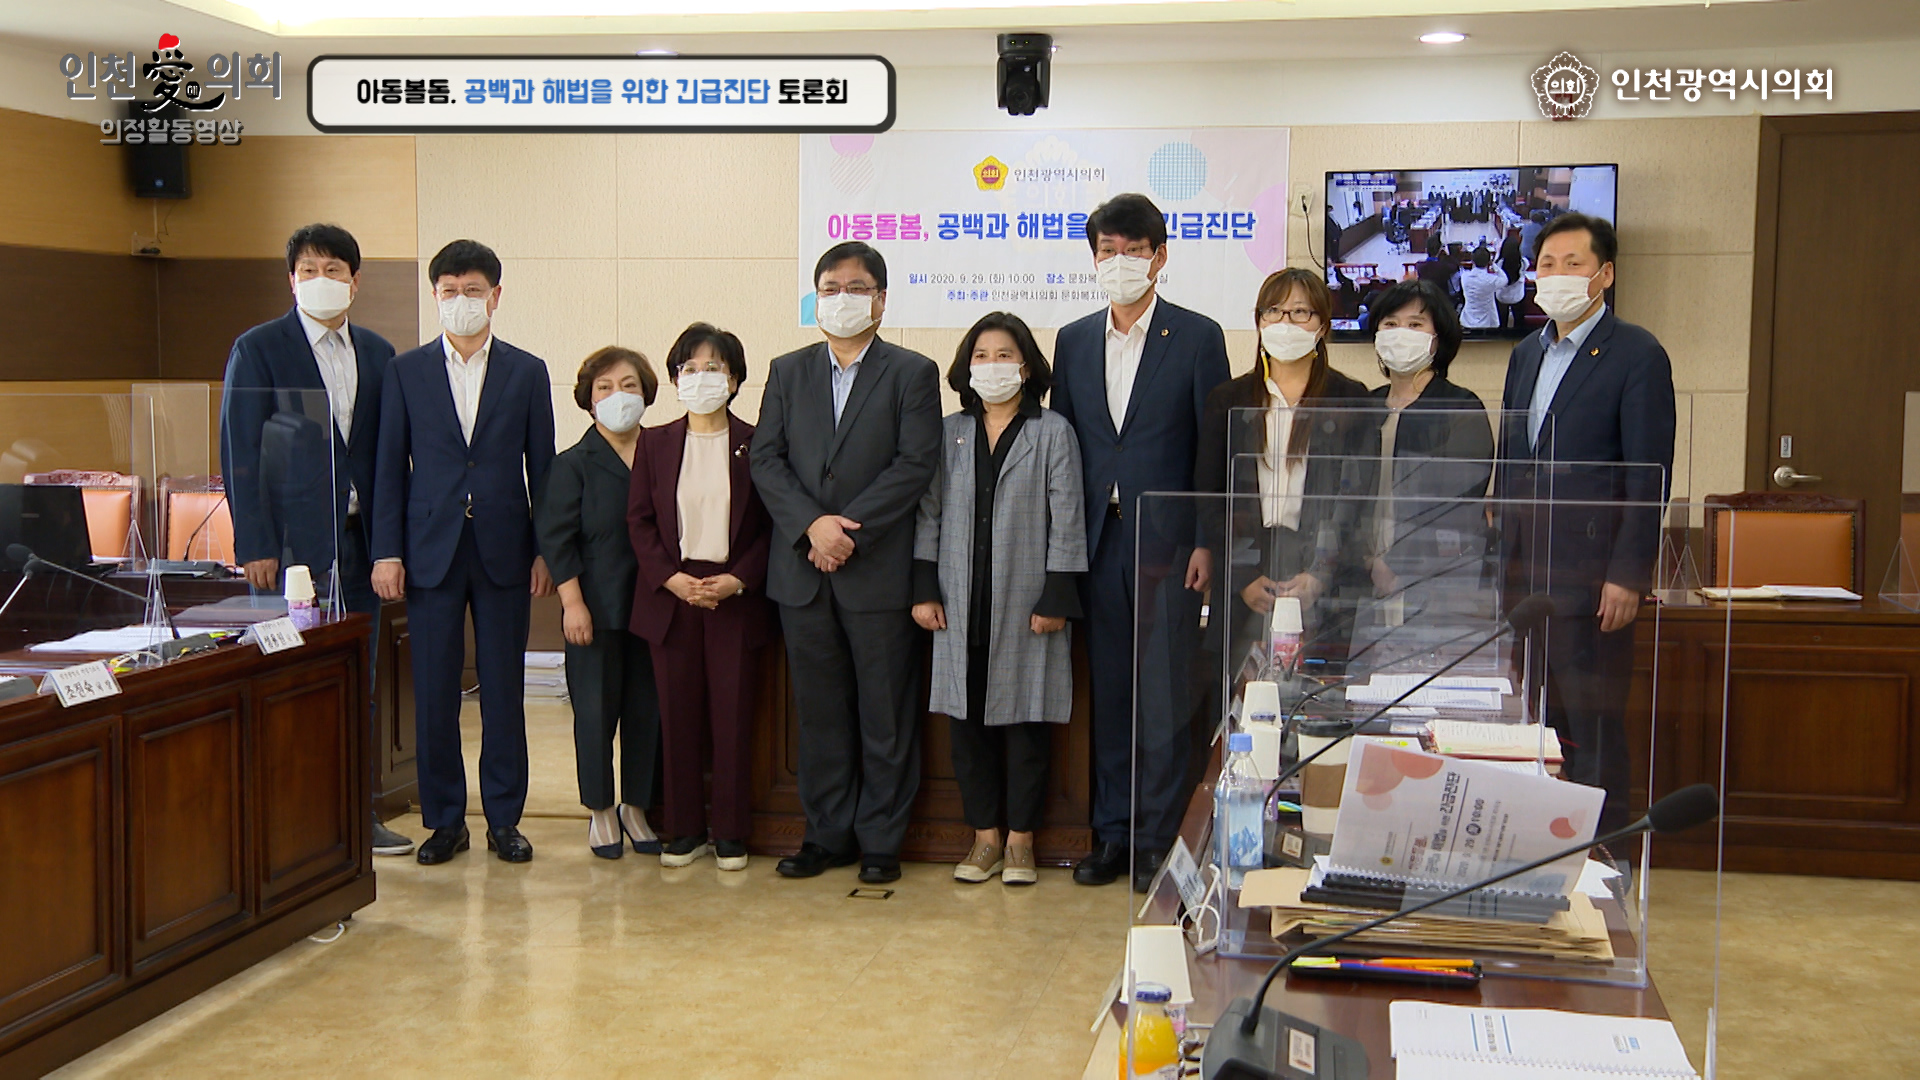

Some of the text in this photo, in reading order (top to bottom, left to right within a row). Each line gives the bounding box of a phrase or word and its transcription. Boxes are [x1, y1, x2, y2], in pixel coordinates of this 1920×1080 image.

[1014, 167, 1105, 182] 인천광역시의회
[827, 213, 930, 242] 아동돌봄,
[937, 212, 1010, 241] 공백과
[1016, 211, 1089, 240] 해법을
[909, 273, 928, 284] 일시
[930, 273, 957, 284] 2020.
